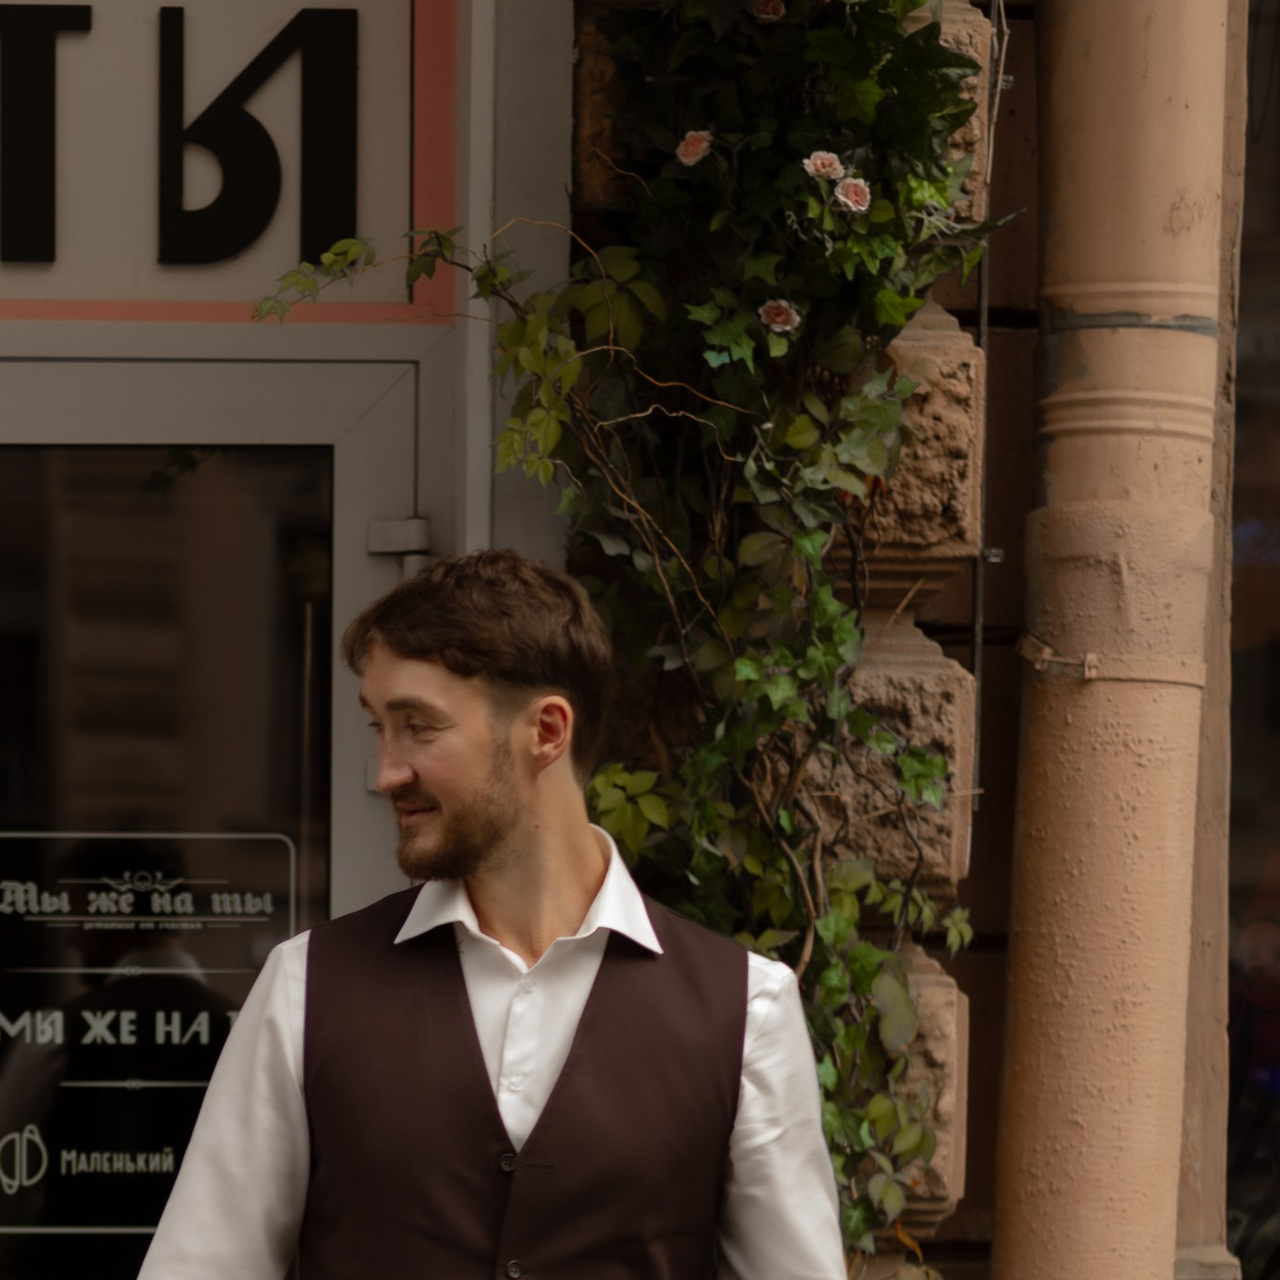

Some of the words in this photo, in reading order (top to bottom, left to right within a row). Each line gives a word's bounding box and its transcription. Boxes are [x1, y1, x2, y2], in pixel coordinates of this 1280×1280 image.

[87, 892, 134, 914] же
[150, 892, 195, 915] на
[80, 1010, 137, 1045] ЖЕ
[155, 1010, 210, 1045] НА
